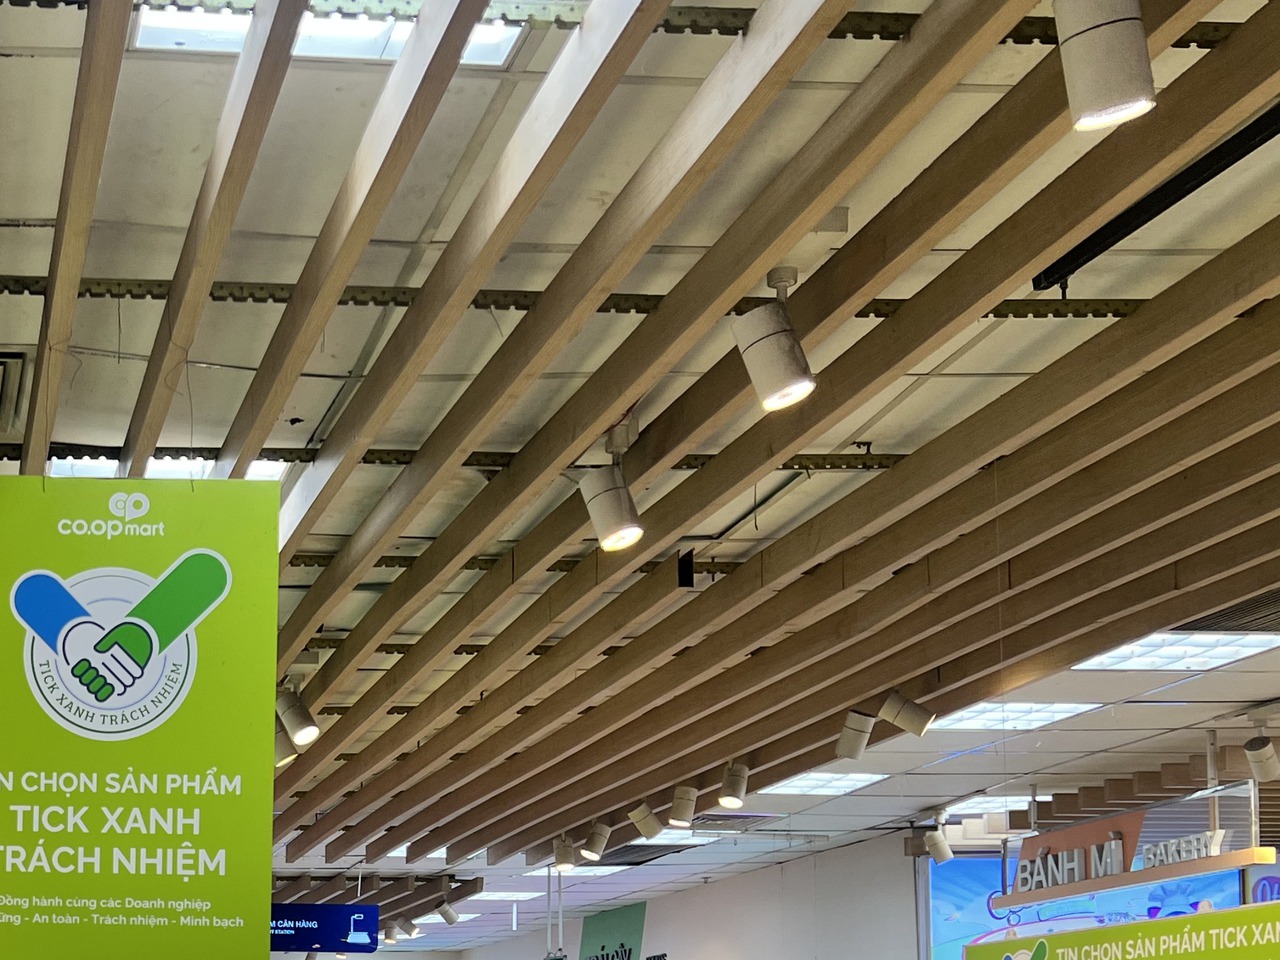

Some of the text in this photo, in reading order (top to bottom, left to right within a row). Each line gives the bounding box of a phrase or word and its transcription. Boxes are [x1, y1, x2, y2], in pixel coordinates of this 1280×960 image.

[39, 660, 182, 725] TICK XANH TRÁCH NHIỆM
[21, 771, 98, 799] CHỌN
[105, 767, 157, 794] SẢN
[166, 766, 241, 796] PHẨM
[10, 805, 200, 836] TICK XANH
[112, 841, 227, 882] NHIỆM
[1018, 829, 1226, 892] BÁNH MÌ BAKERY
[33, 896, 62, 906] hành
[66, 897, 97, 910] cùng
[100, 897, 121, 908] các
[125, 898, 165, 909] Doanh
[168, 898, 211, 911] nghiệp
[33, 913, 49, 924] An
[52, 913, 79, 924] toàn
[91, 914, 126, 925] Trách
[130, 915, 167, 927] nhiệm
[180, 916, 209, 926] Minh
[213, 916, 244, 930] bạch
[278, 919, 318, 928] CÂN HÀNG
[1126, 932, 1156, 960] SẢN
[1160, 924, 1205, 956] PHẨM
[1209, 925, 1248, 950] TICK
